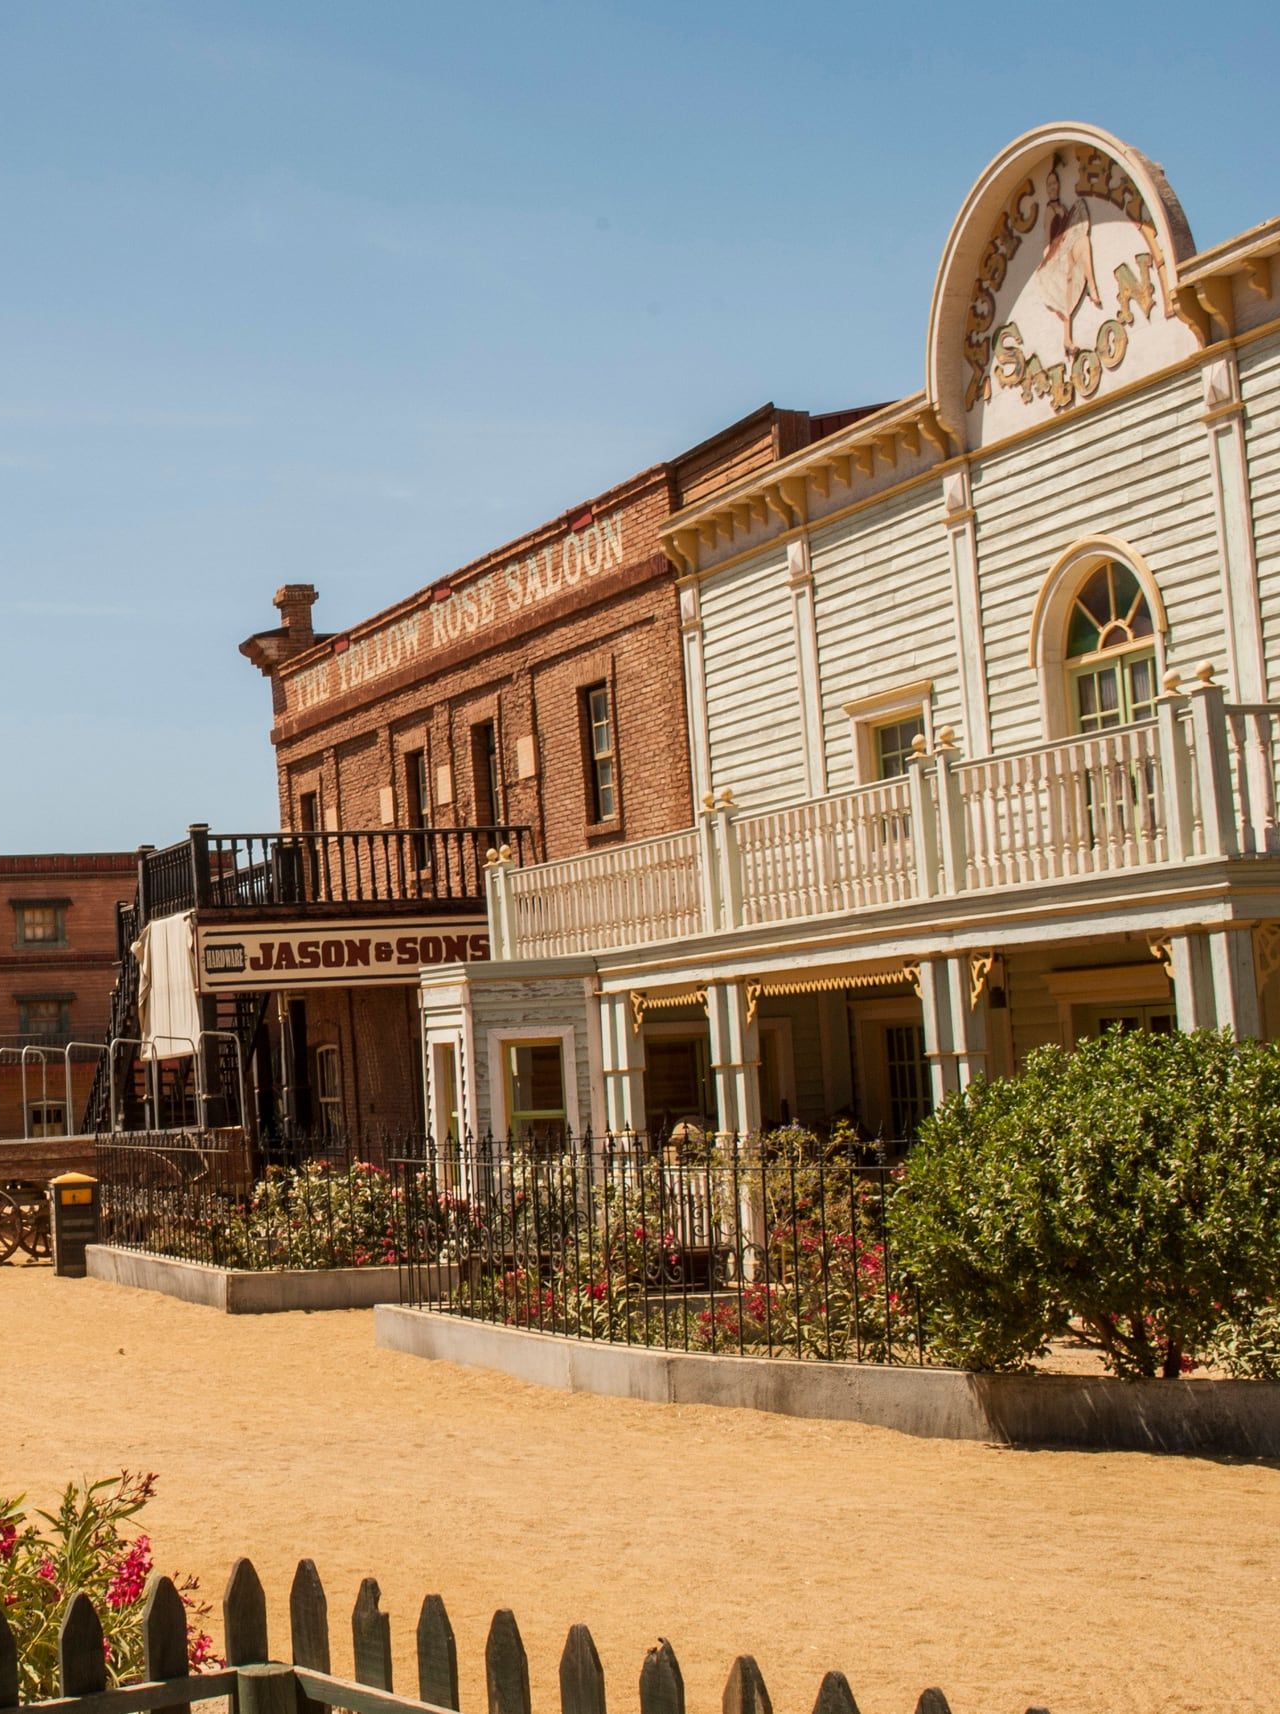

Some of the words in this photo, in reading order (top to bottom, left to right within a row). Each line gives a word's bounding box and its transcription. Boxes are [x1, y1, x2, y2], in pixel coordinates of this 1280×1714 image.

[991, 253, 1157, 414] SALOON
[293, 660, 330, 711] THE
[335, 609, 420, 692] YELLOW
[429, 573, 496, 649] ROSE
[503, 512, 624, 613] SALOON
[206, 949, 243, 968] HARDWARE
[250, 939, 371, 971] JASON
[374, 941, 393, 962] &
[397, 934, 490, 965] SONS
